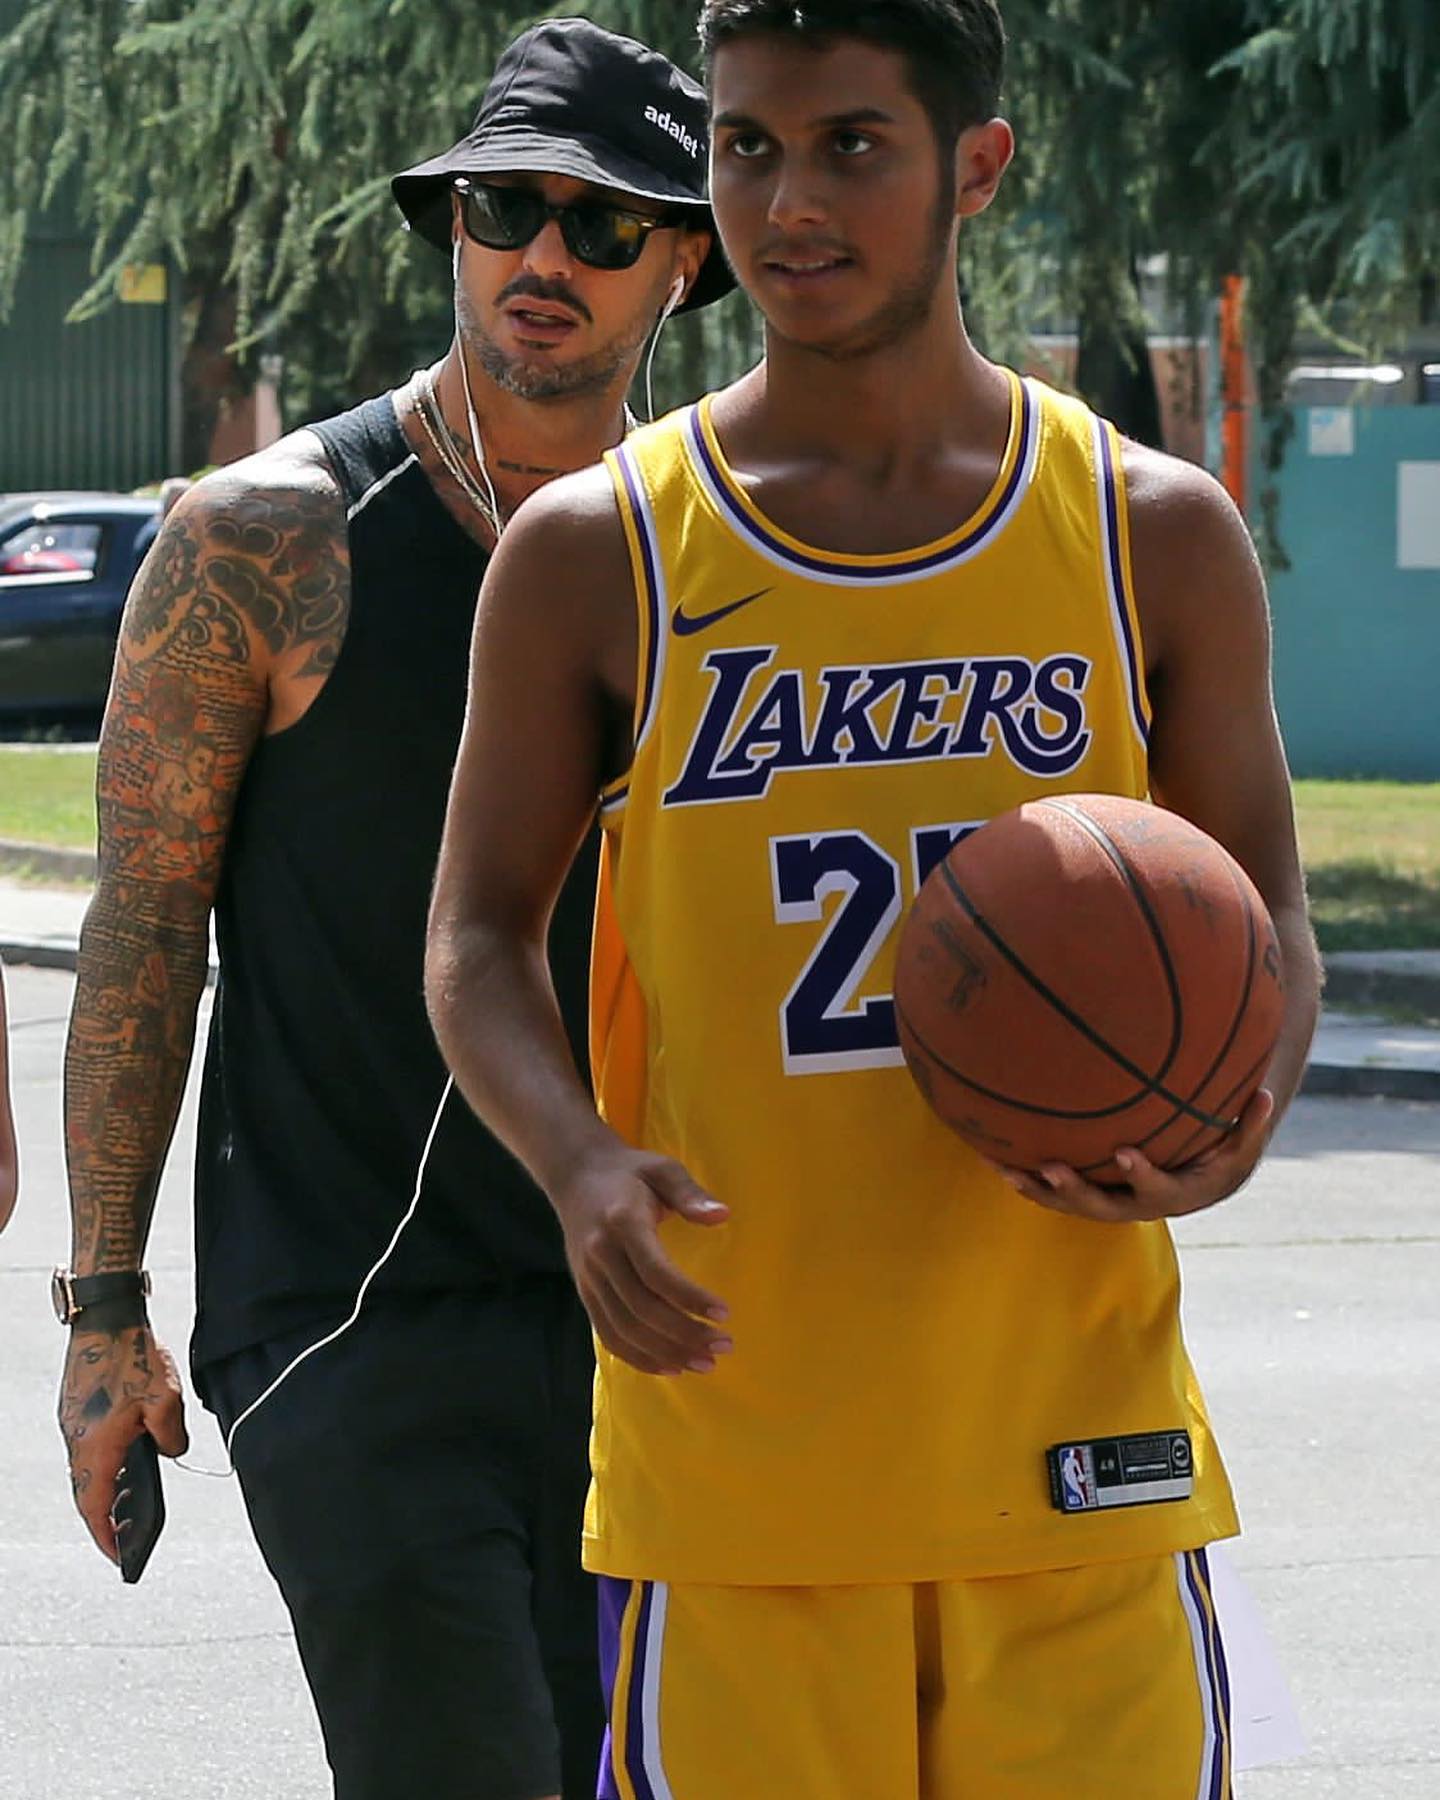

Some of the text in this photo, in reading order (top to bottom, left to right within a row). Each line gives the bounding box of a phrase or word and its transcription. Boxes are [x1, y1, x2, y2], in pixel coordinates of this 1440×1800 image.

[644, 105, 698, 158] adalet
[662, 645, 1093, 809] LAKERS
[768, 820, 989, 1076] 2
